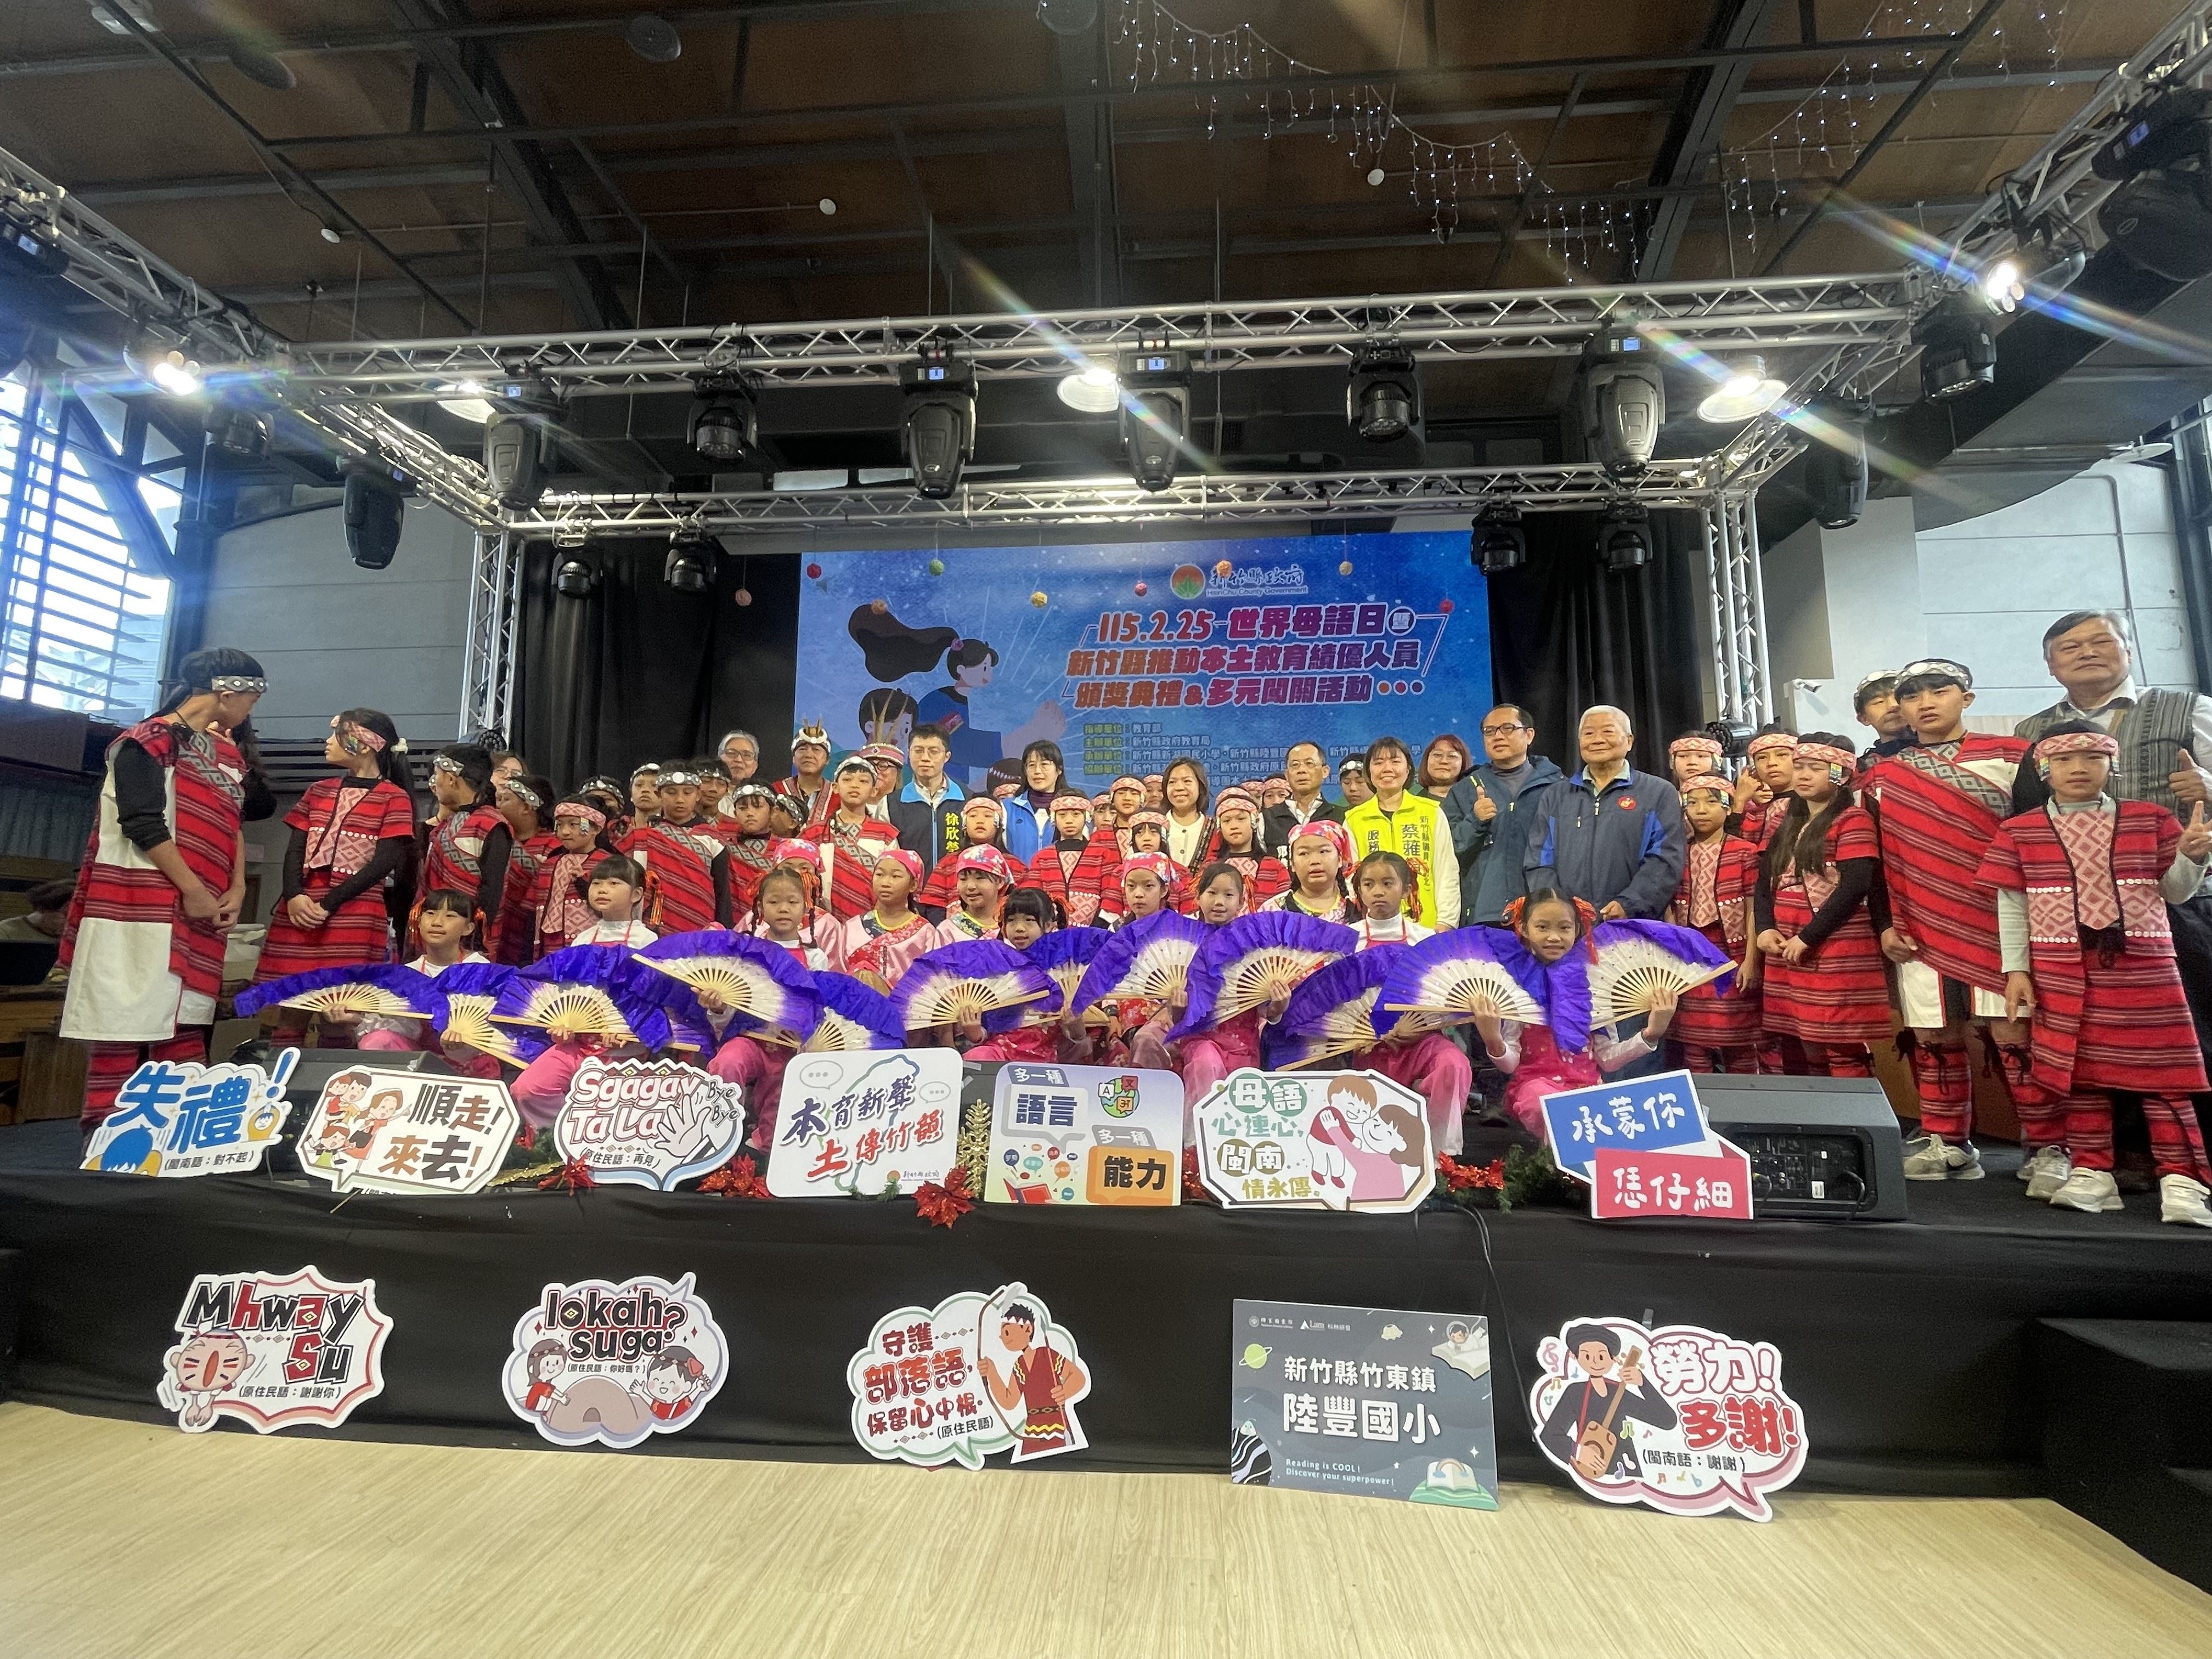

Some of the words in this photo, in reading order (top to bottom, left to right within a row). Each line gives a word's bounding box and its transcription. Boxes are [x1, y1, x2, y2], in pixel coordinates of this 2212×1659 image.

[1239, 587, 1262, 597] County
[1265, 586, 1308, 595] Government
[1099, 610, 1215, 642] 115.2.25
[1228, 604, 1387, 639] 世界母語日
[1402, 823, 1420, 856] 蔡雅
[708, 1081, 736, 1104] Bye
[1014, 1068, 1065, 1085] 多一種
[1102, 1086, 1110, 1095] A
[408, 1083, 504, 1136] 順走!
[1016, 1092, 1077, 1127] 語言
[1232, 1078, 1303, 1113] 母語
[712, 1104, 739, 1127] Bye
[1571, 1092, 1685, 1144] 承蒙你
[1098, 1128, 1151, 1147] 多一種
[378, 1133, 483, 1183] 來去!
[1104, 1155, 1167, 1190] 能力
[1220, 1144, 1284, 1175] 閩南
[1612, 1166, 1733, 1212] 恁仔細
[182, 1280, 366, 1345] Mhway
[882, 1322, 934, 1357] 守護
[283, 1331, 354, 1385] Su
[1284, 1356, 1437, 1393] 新竹縣竹東鎮
[1283, 1392, 1441, 1444] 陸豐國小
[1678, 1393, 1801, 1457] 多謝!
[1286, 1458, 1320, 1470] Reading
[1323, 1462, 1330, 1470] is
[1286, 1468, 1320, 1479] Discover
[1322, 1472, 1340, 1481] your
[1342, 1474, 1394, 1486] superpower!
